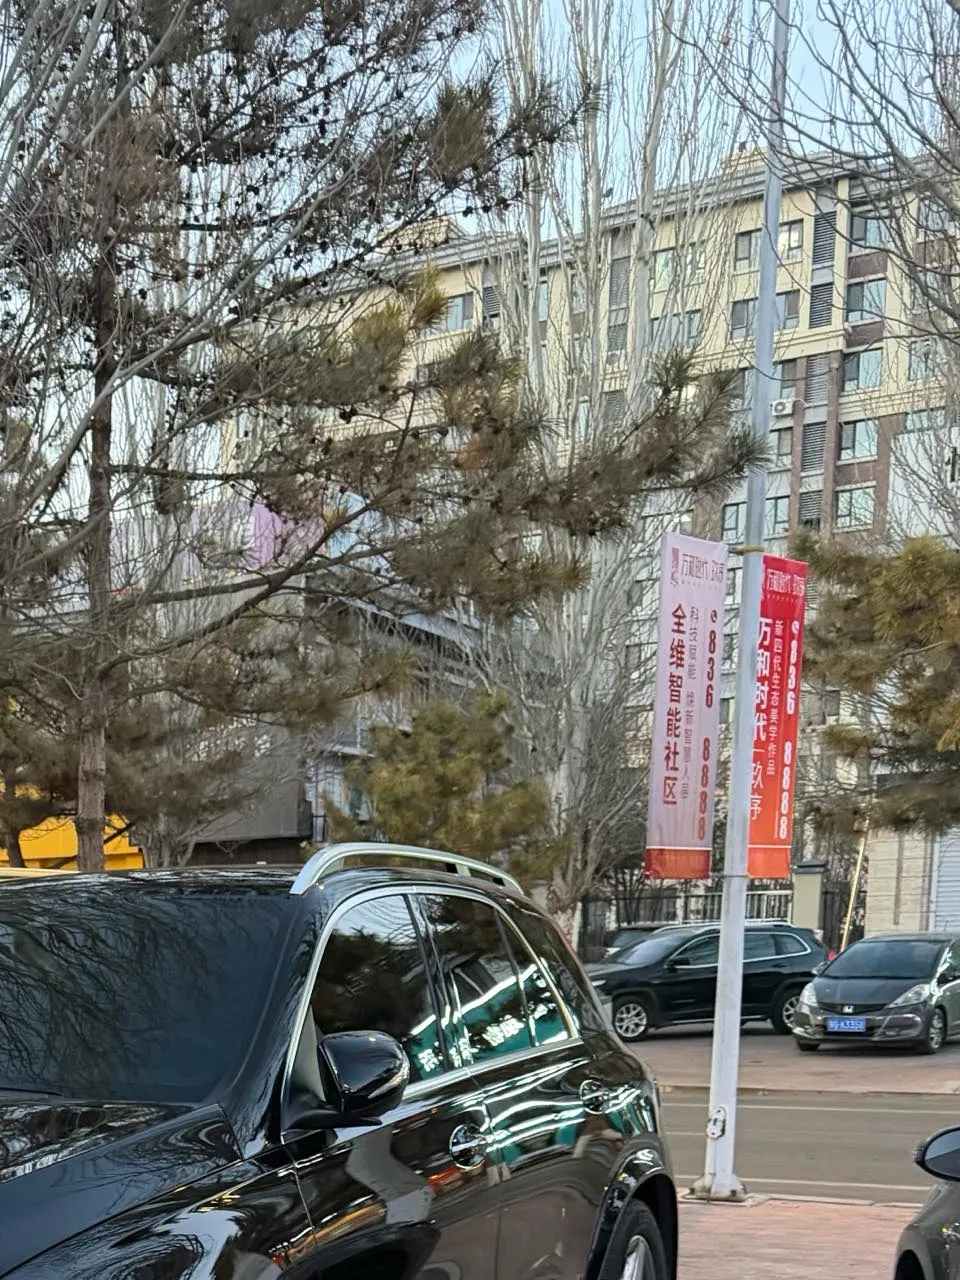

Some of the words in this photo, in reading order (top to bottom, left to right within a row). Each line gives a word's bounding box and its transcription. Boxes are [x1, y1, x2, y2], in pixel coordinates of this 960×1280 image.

[663, 603, 687, 805] 全维智能社区
[705, 630, 717, 708] 836
[786, 640, 798, 715] 836
[696, 737, 710, 840] 8888
[779, 741, 792, 840] 8888
